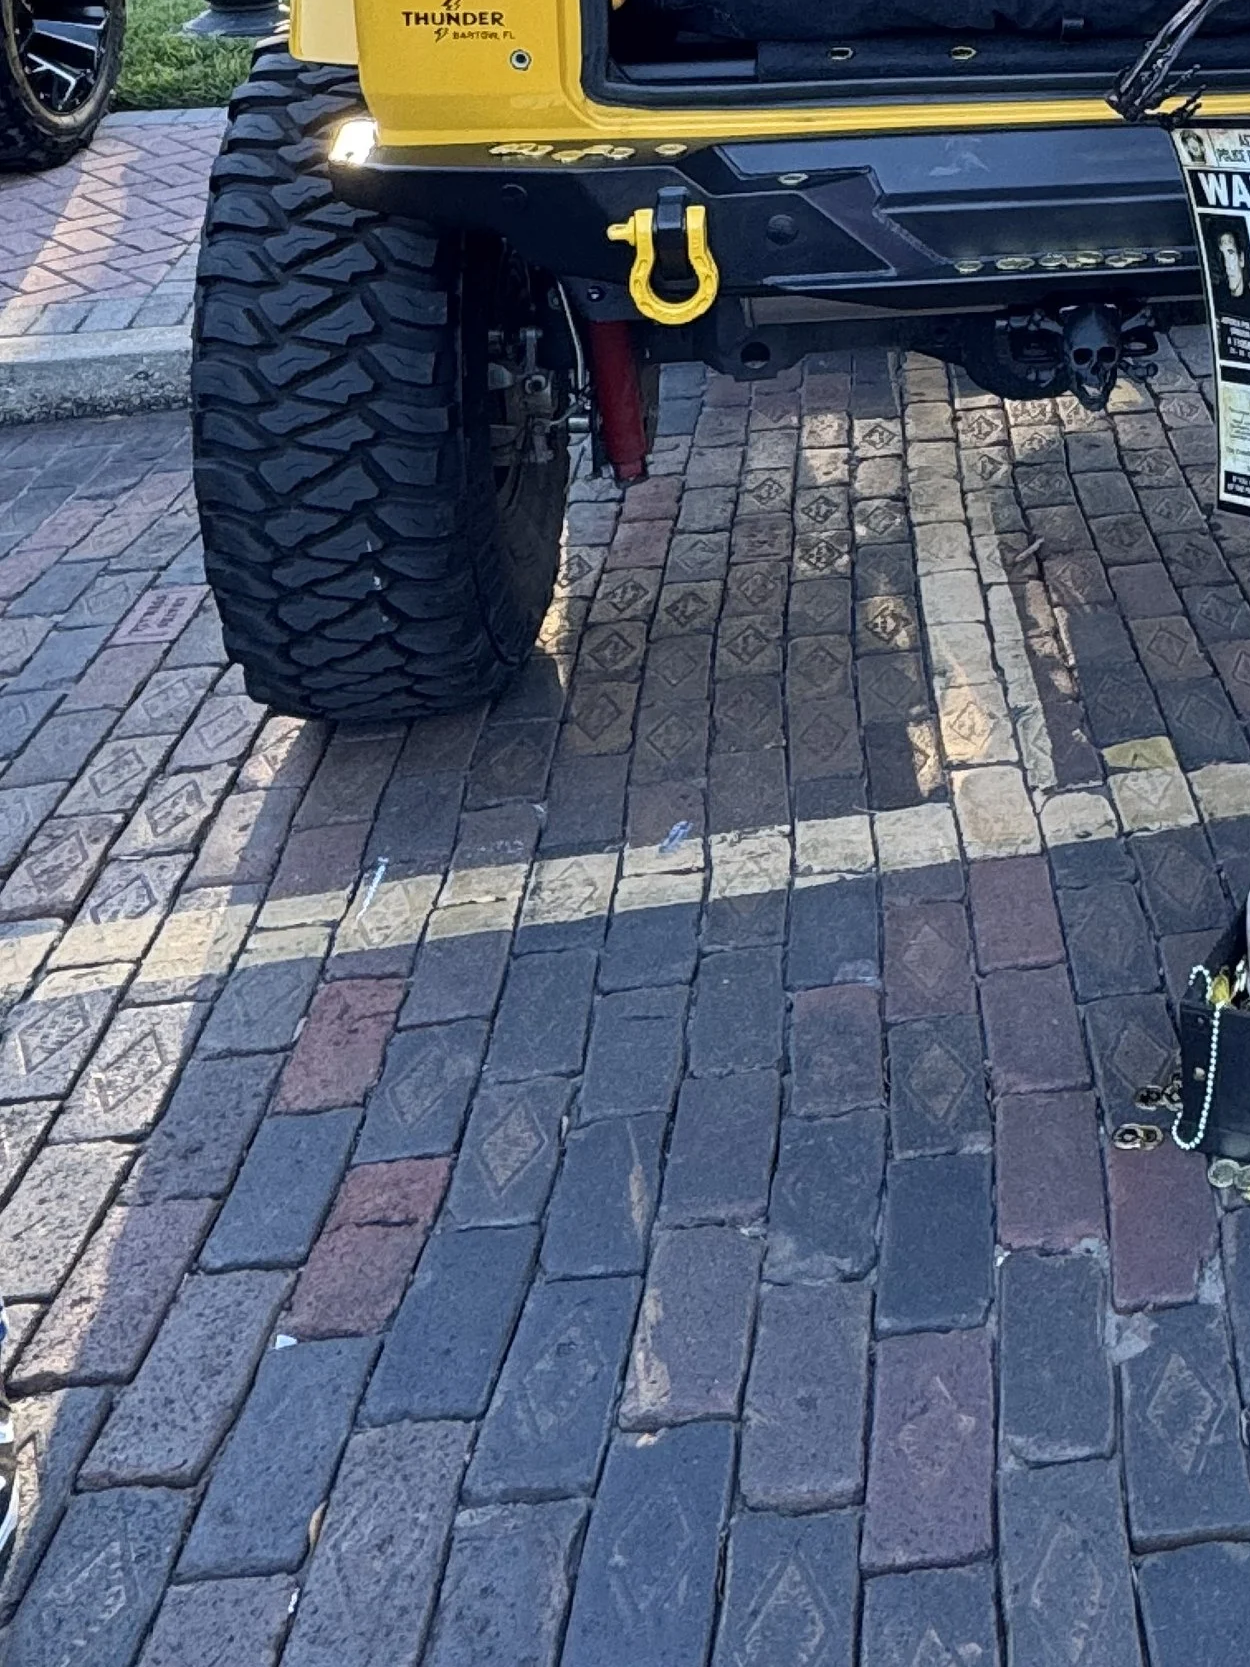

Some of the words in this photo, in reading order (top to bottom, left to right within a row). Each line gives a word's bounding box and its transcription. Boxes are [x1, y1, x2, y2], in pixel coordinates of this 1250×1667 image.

[401, 11, 505, 27] THUNDER
[502, 30, 516, 40] FL
[1216, 148, 1247, 163] POLICE
